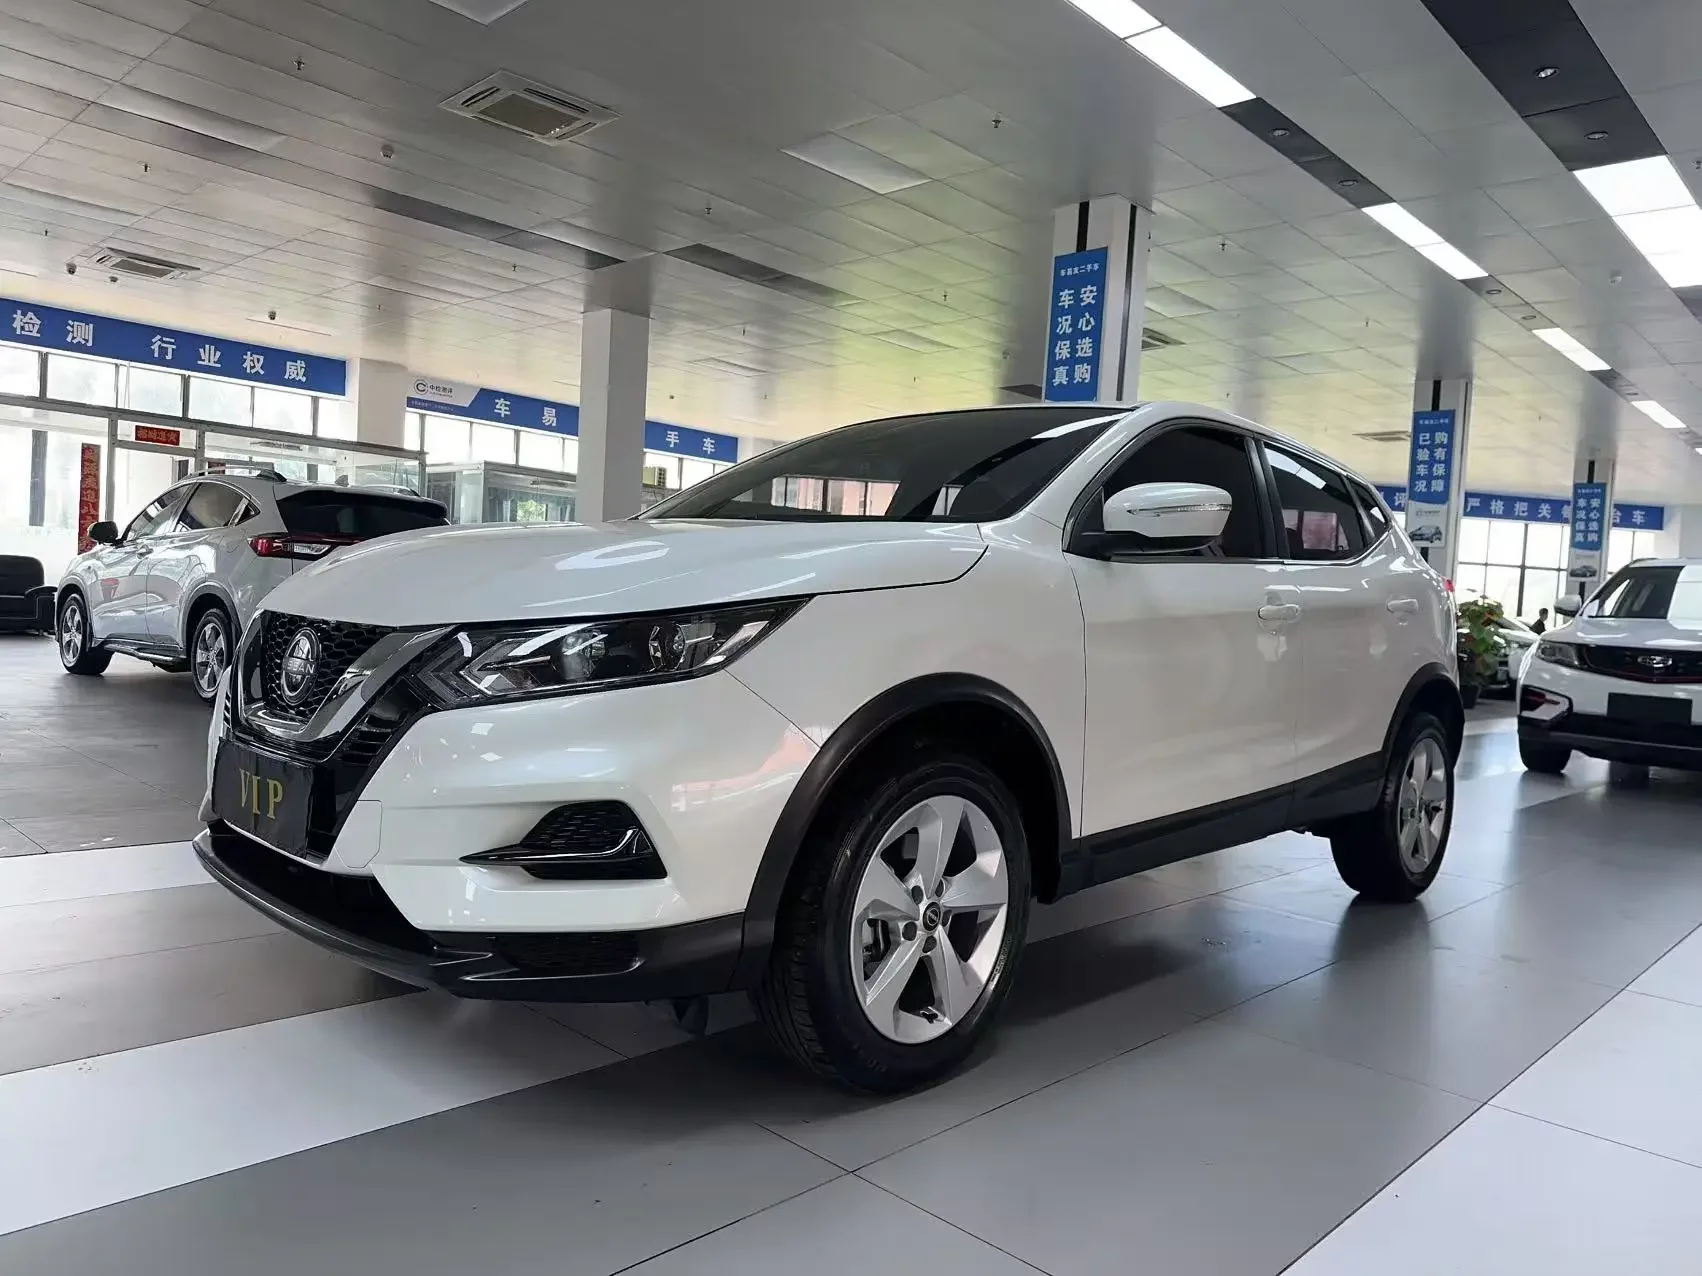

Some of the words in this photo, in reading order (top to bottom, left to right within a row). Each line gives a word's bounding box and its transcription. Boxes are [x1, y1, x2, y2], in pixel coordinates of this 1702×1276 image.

[12, 309, 94, 347] 检测
[151, 335, 307, 383] 行业权威
[1052, 289, 1075, 387] 车况保真
[1073, 285, 1097, 384] 安心选购
[494, 398, 557, 427] 车易
[665, 430, 716, 455] 手车
[1414, 432, 1431, 493] 已验车况
[1431, 431, 1449, 493] 购有保障
[239, 768, 284, 819] VIP
